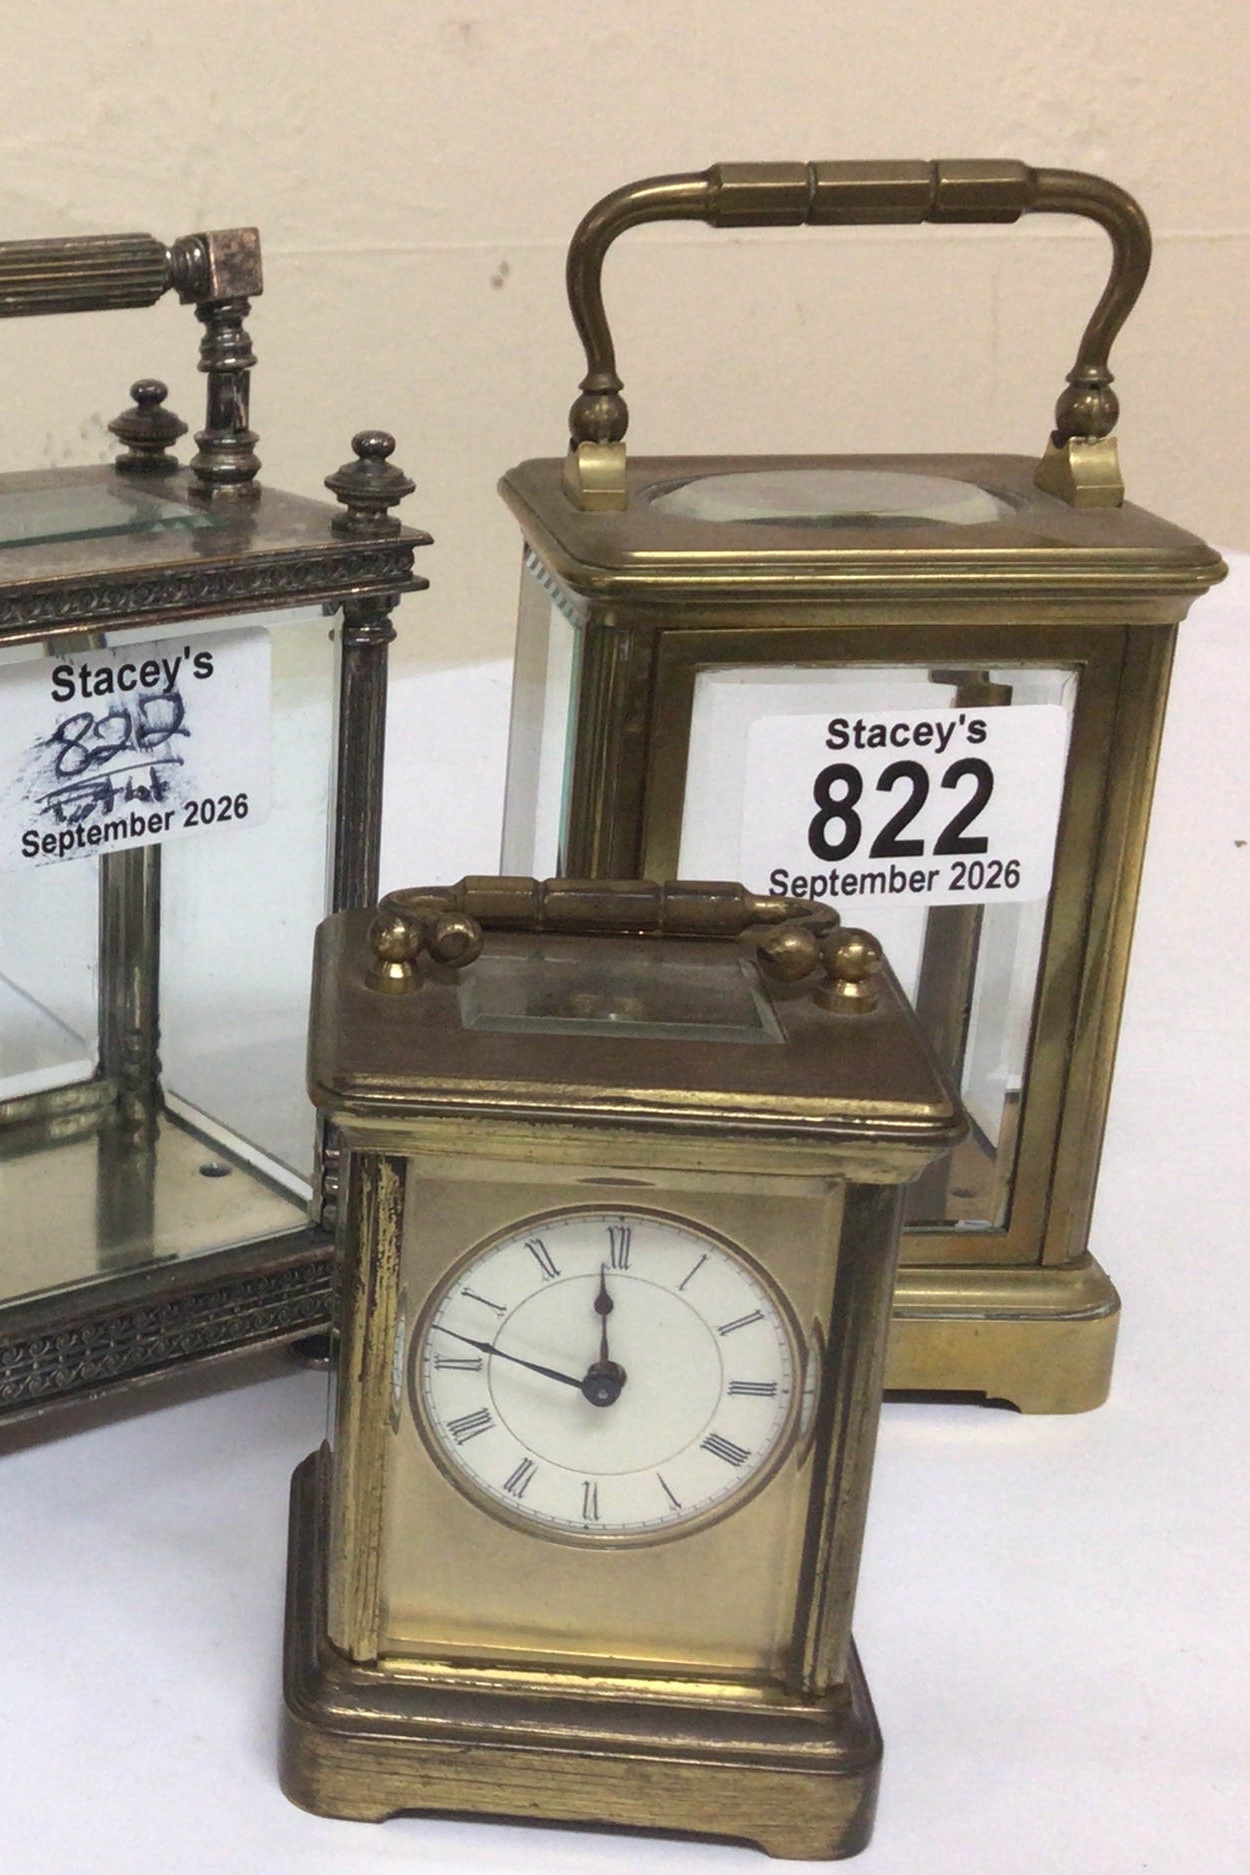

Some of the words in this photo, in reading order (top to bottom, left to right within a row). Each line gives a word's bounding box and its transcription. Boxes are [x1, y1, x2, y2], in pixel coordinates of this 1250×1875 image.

[51, 646, 214, 702] Stacey's
[825, 714, 987, 754] Stacey's
[21, 810, 175, 857] September
[183, 793, 248, 828] 2026
[807, 757, 994, 862] 822
[769, 864, 940, 900] September
[948, 859, 1021, 891] 2026
[524, 1238, 561, 1282] XI
[600, 1225, 631, 1271] XII
[679, 1253, 707, 1290] I
[461, 1287, 507, 1317] X
[716, 1308, 765, 1336] II
[434, 1355, 483, 1371] IX
[727, 1380, 778, 1397] III
[447, 1406, 496, 1446] VIII
[503, 1456, 539, 1499] VII
[657, 1472, 682, 1511] V
[582, 1480, 599, 1521] VI
